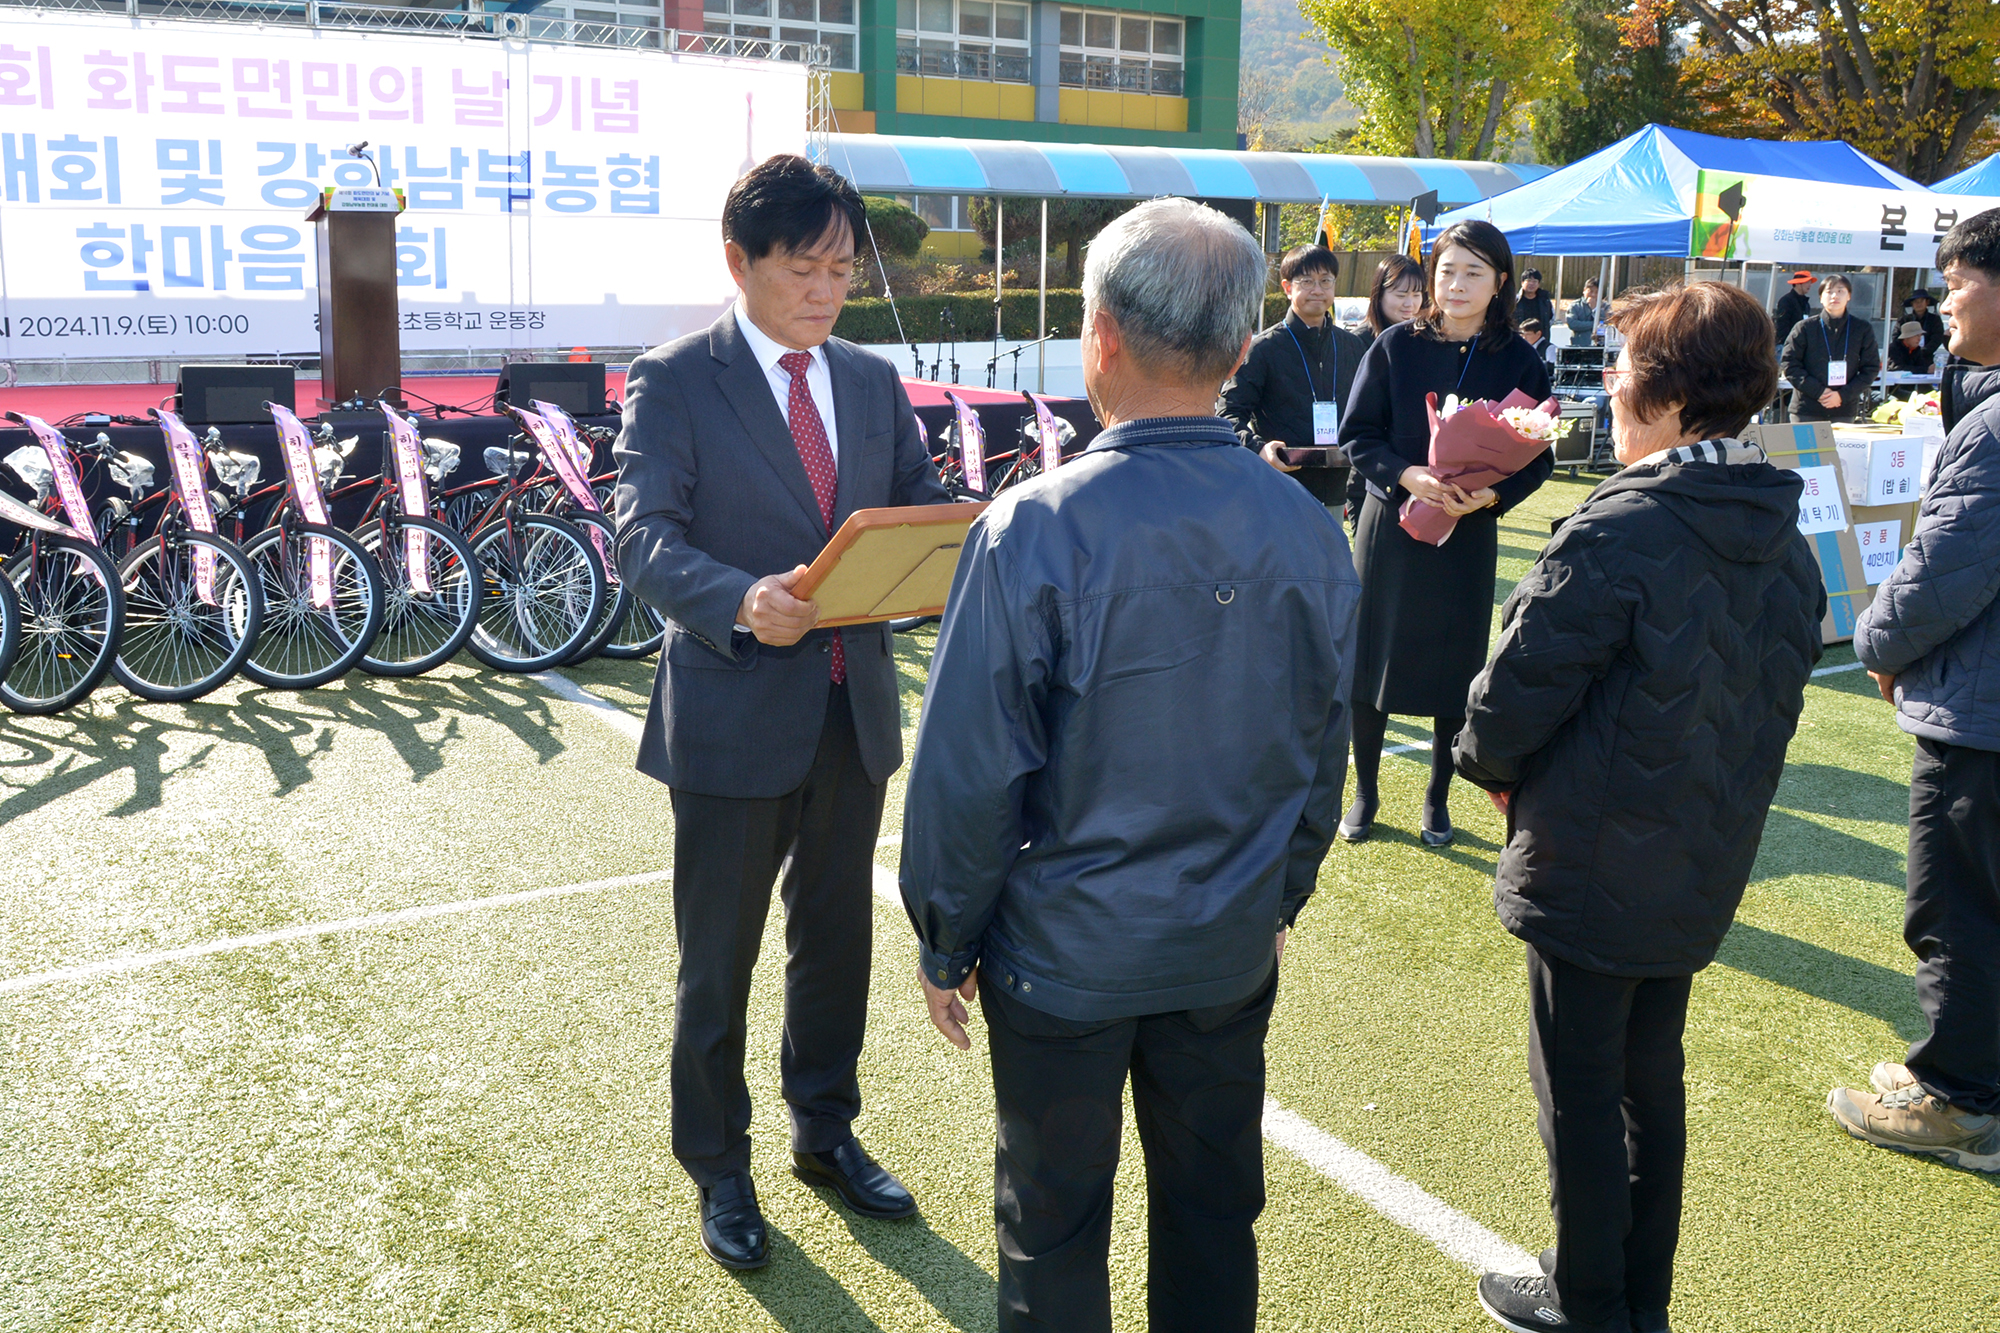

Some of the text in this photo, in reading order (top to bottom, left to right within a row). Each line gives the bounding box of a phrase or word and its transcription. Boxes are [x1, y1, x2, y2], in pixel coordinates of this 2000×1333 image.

[84, 49, 424, 124] 화도면민의
[452, 68, 509, 127] 날
[533, 75, 639, 133] 기념
[155, 138, 226, 206] 및
[1773, 228, 1853, 244] 강화남부농협 한마음 대회
[76, 222, 306, 291] 한마음
[19, 314, 177, 337] 2024.11.9.(토)
[185, 314, 249, 335] 10:00
[398, 311, 482, 331] 초등학교
[489, 311, 546, 331] 운동장
[1316, 427, 1335, 435] STAFF
[1840, 442, 1866, 450] CUCKOO
[1890, 450, 1905, 468] 3등
[1803, 478, 1820, 496] 2등
[312, 538, 329, 560] 세구
[409, 532, 425, 554] 세구
